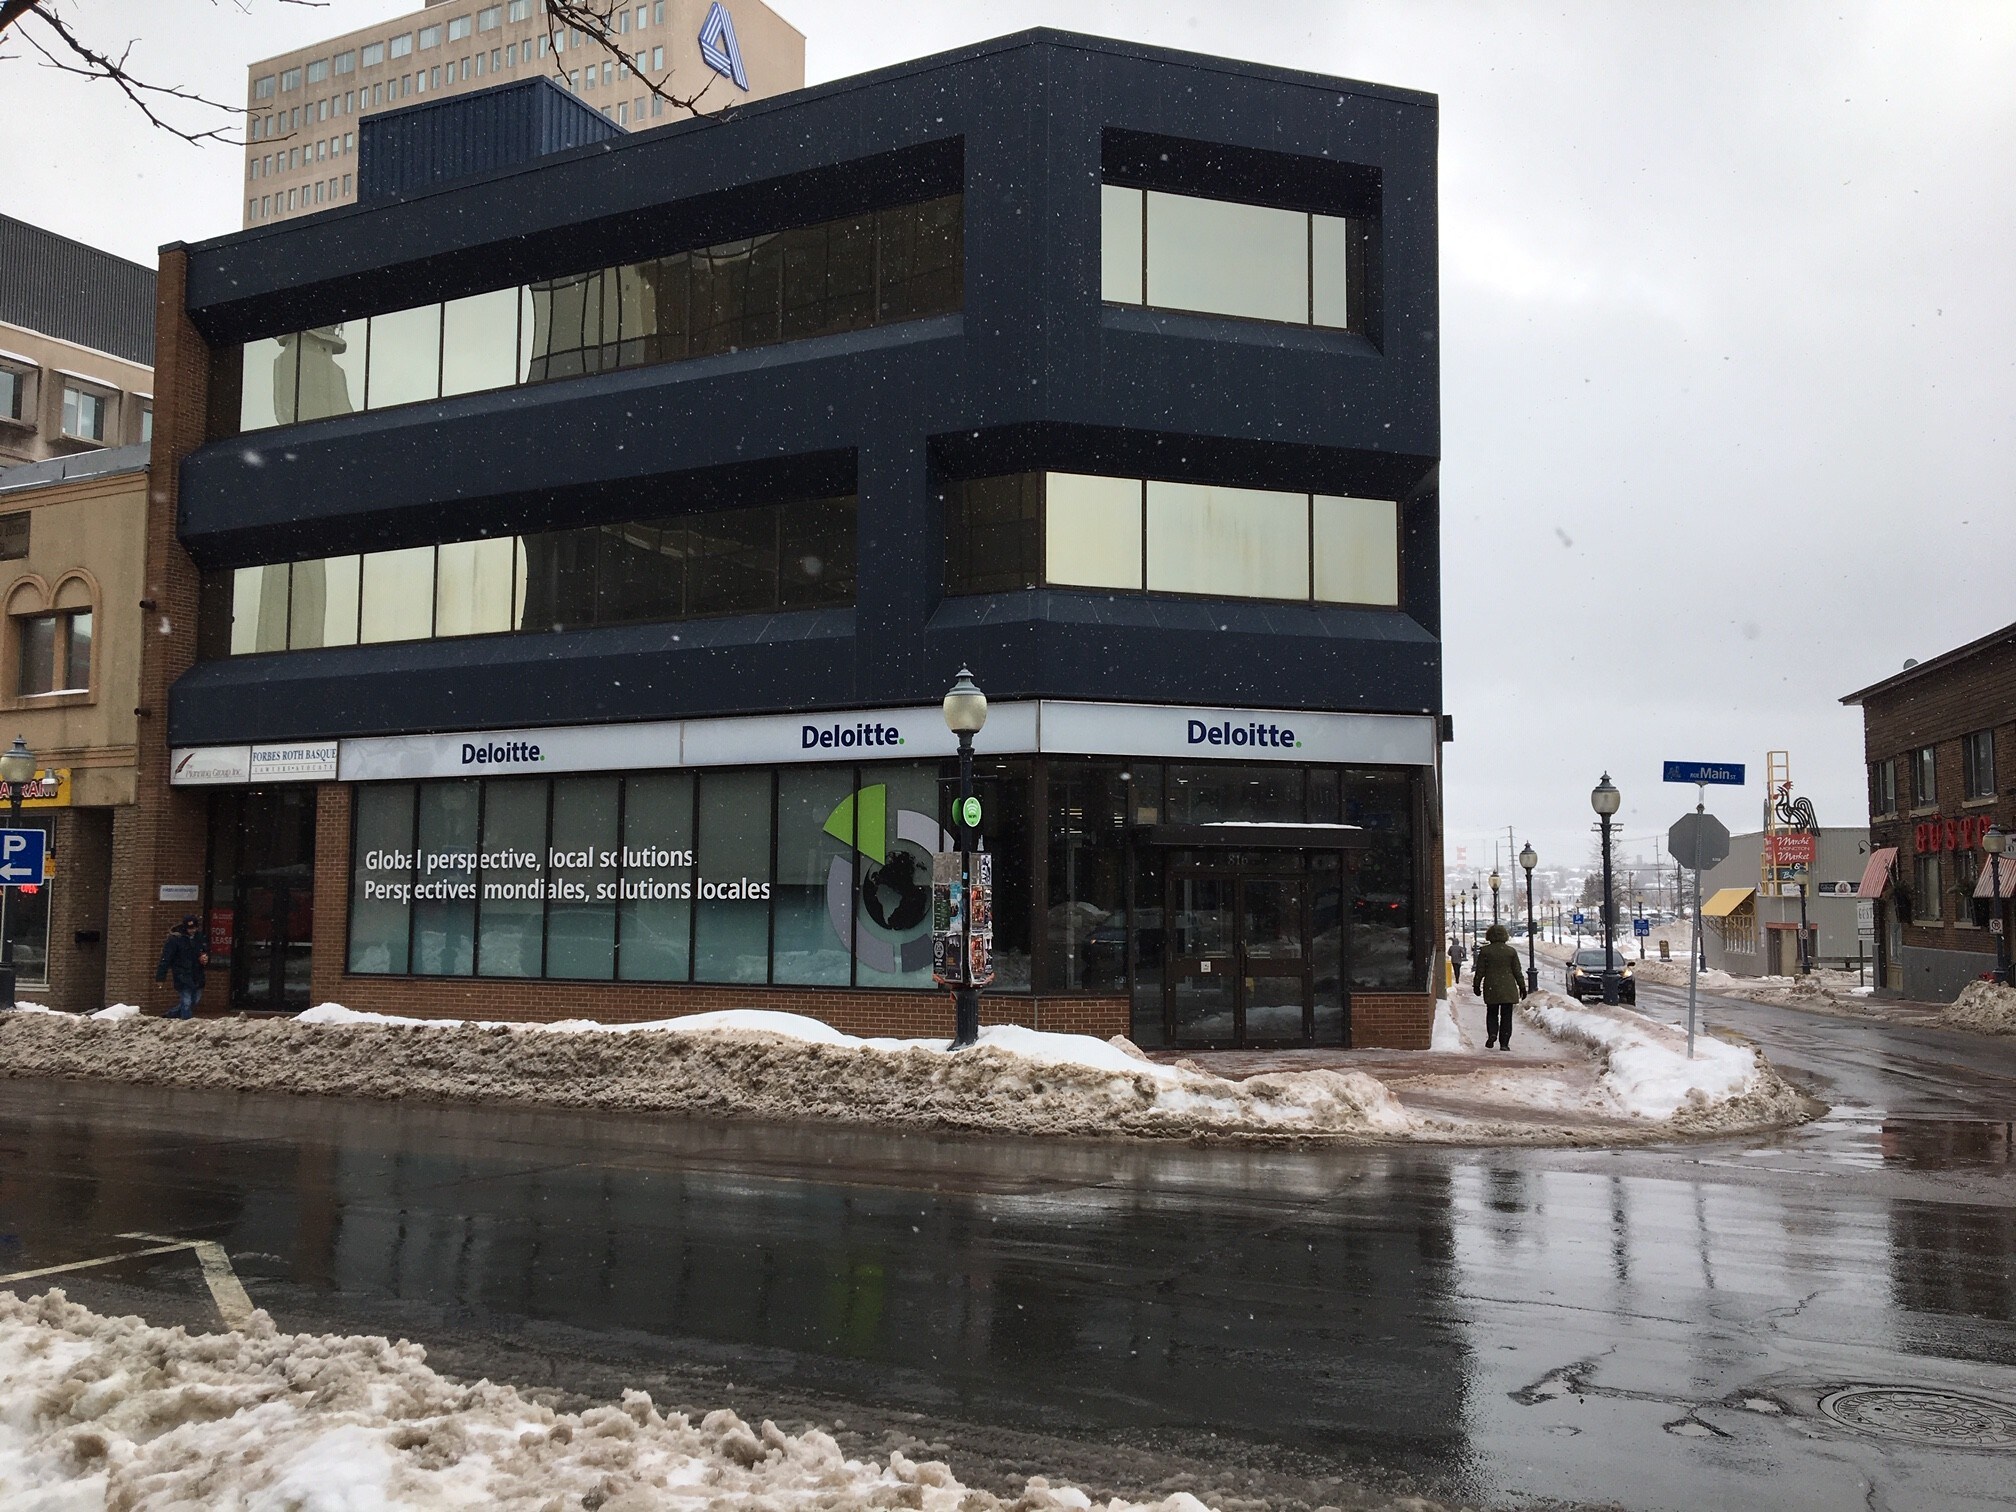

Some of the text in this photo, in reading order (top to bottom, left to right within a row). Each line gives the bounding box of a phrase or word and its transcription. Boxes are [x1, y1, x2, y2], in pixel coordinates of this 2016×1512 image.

[802, 723, 905, 749] Deloitte.
[1187, 719, 1302, 748] Deloitte.
[252, 748, 337, 762] FORBES ROTH BASQUE
[462, 742, 545, 765] Deloitte.
[1700, 767, 1730, 780] Main
[3, 835, 27, 860] P
[1777, 837, 1811, 846] Marché
[365, 849, 422, 870] Global
[427, 848, 541, 875] perspective,
[549, 846, 594, 868] local
[1227, 854, 1249, 865] 816
[1777, 852, 1810, 861] Market
[365, 877, 770, 905] Perspectives mondiales, solutions locales
[211, 928, 226, 936] FOR
[211, 937, 232, 945] LEASE
